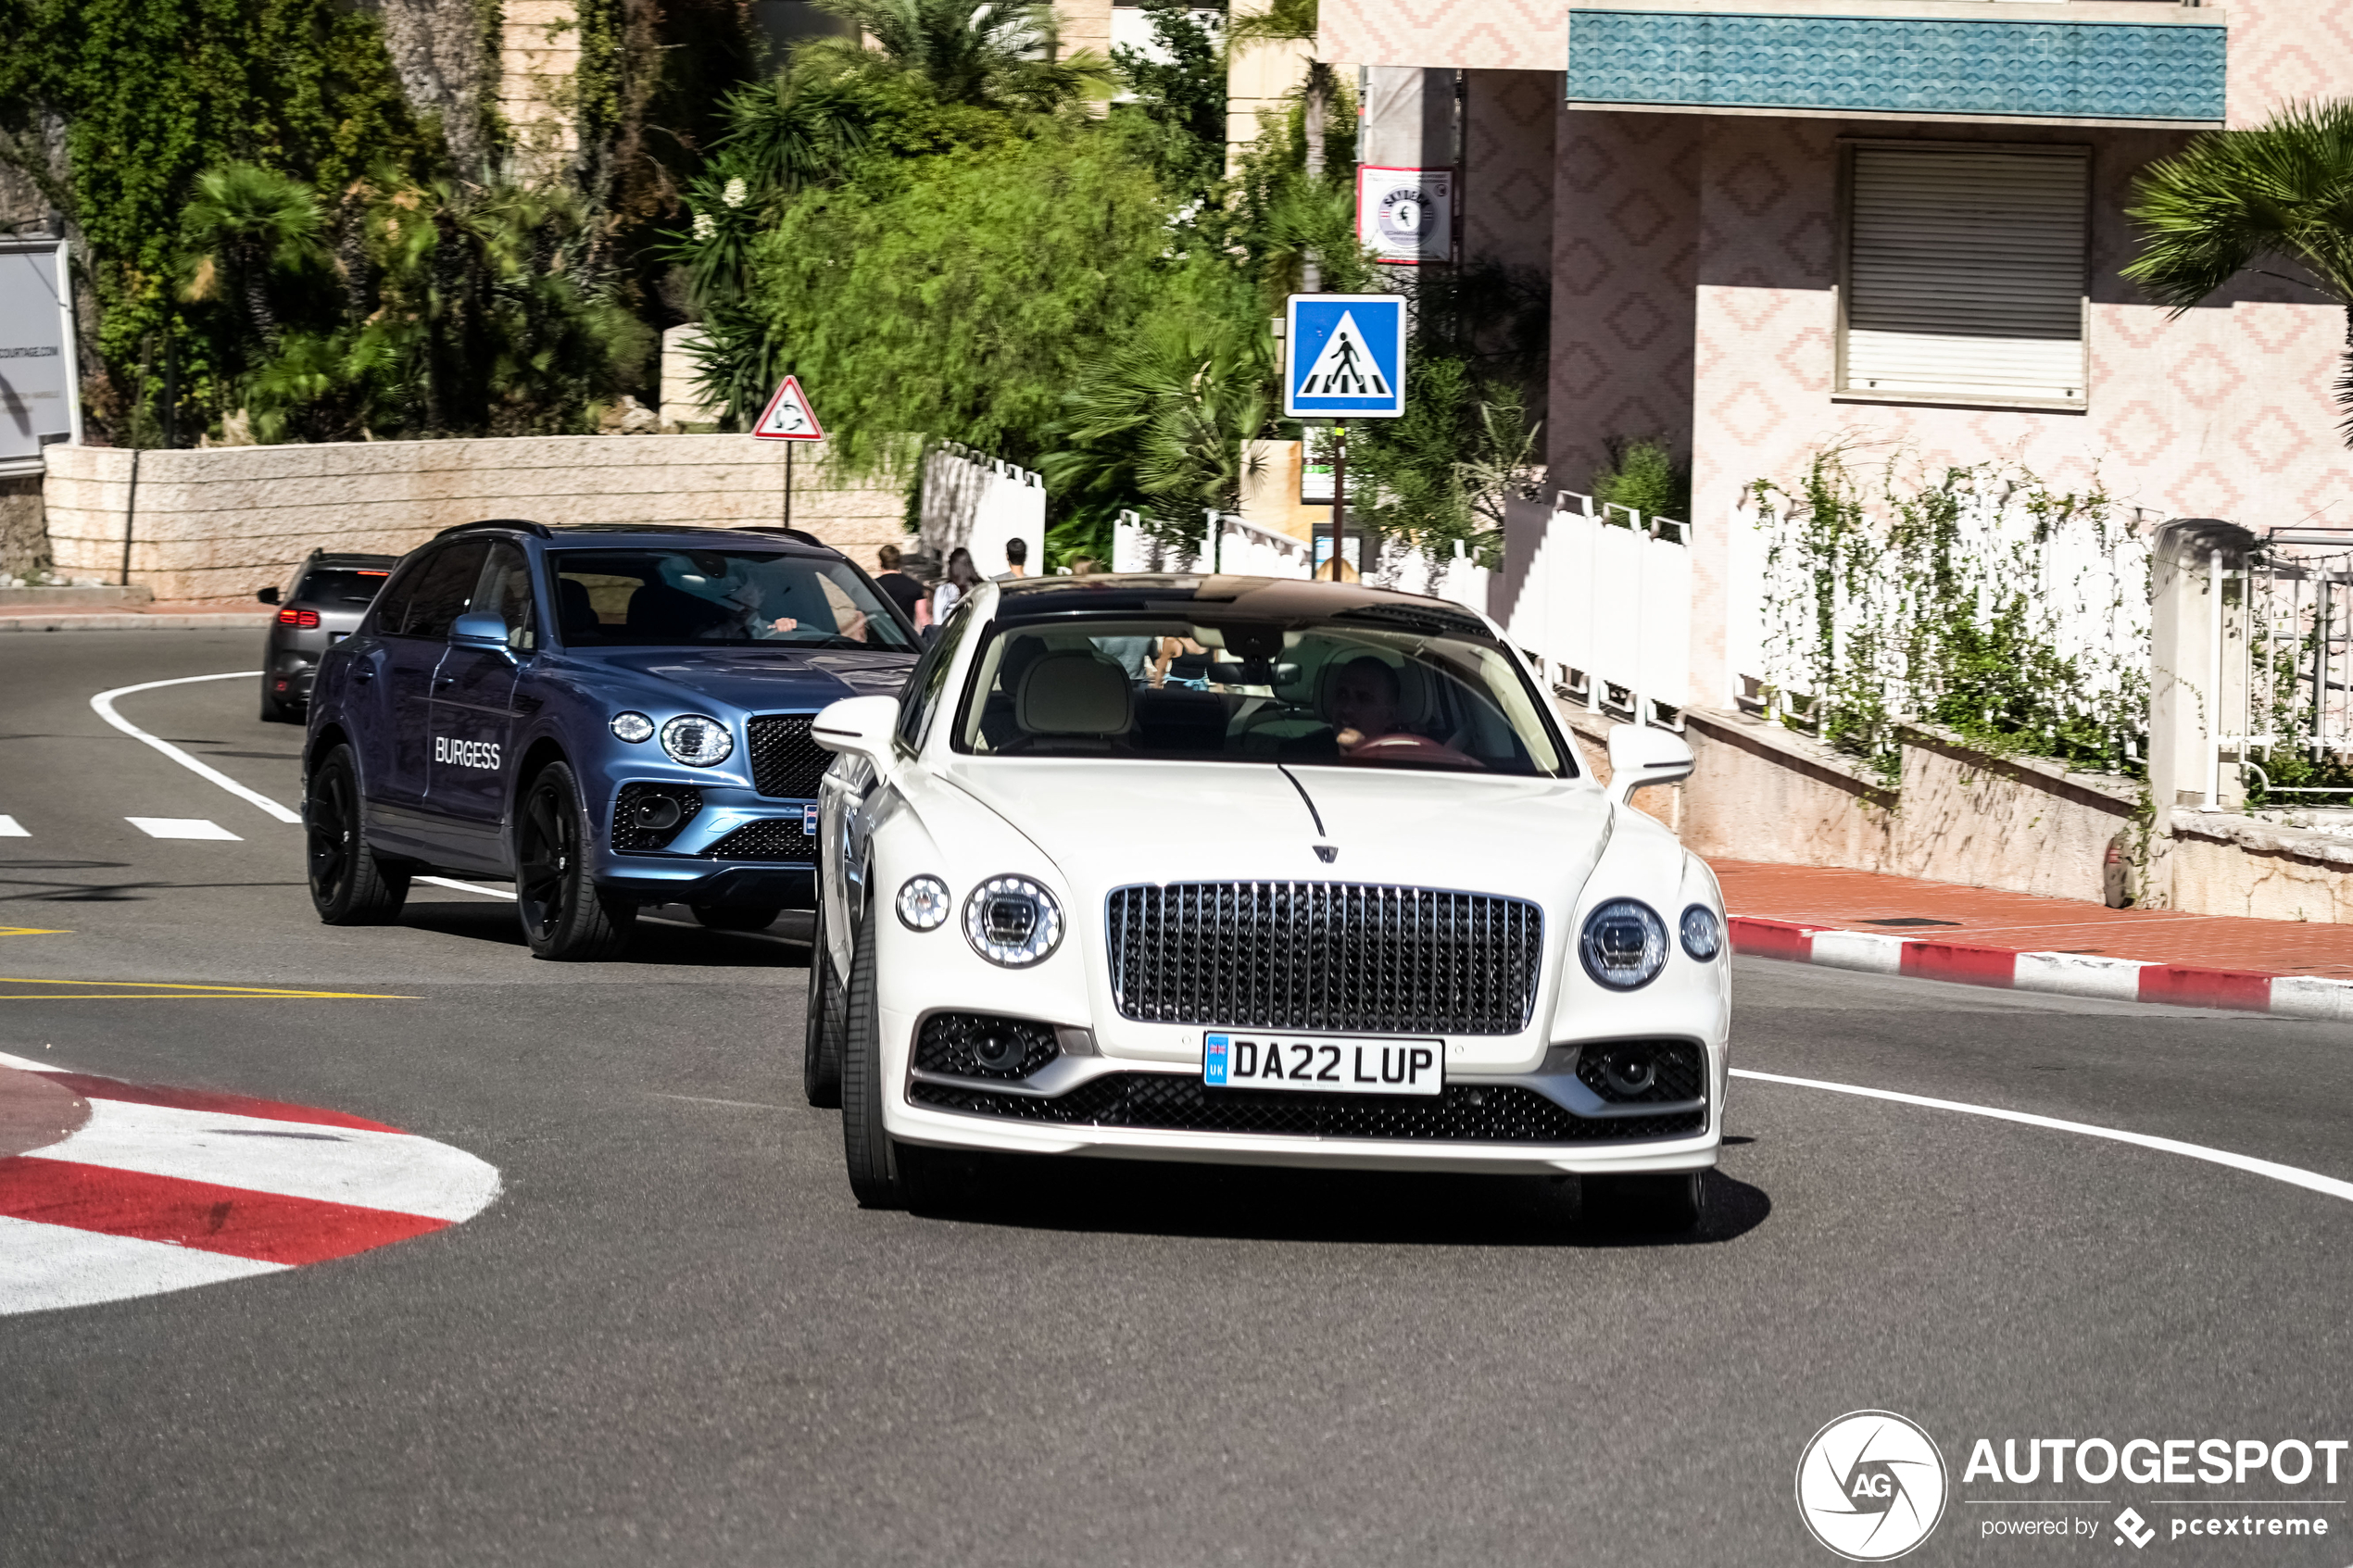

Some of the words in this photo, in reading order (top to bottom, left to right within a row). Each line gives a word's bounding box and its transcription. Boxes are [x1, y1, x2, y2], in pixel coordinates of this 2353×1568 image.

[435, 736, 500, 770] BURGESS
[1209, 1064, 1224, 1076] UK
[1233, 1040, 1341, 1082] DA22
[1353, 1046, 1433, 1085] LUP
